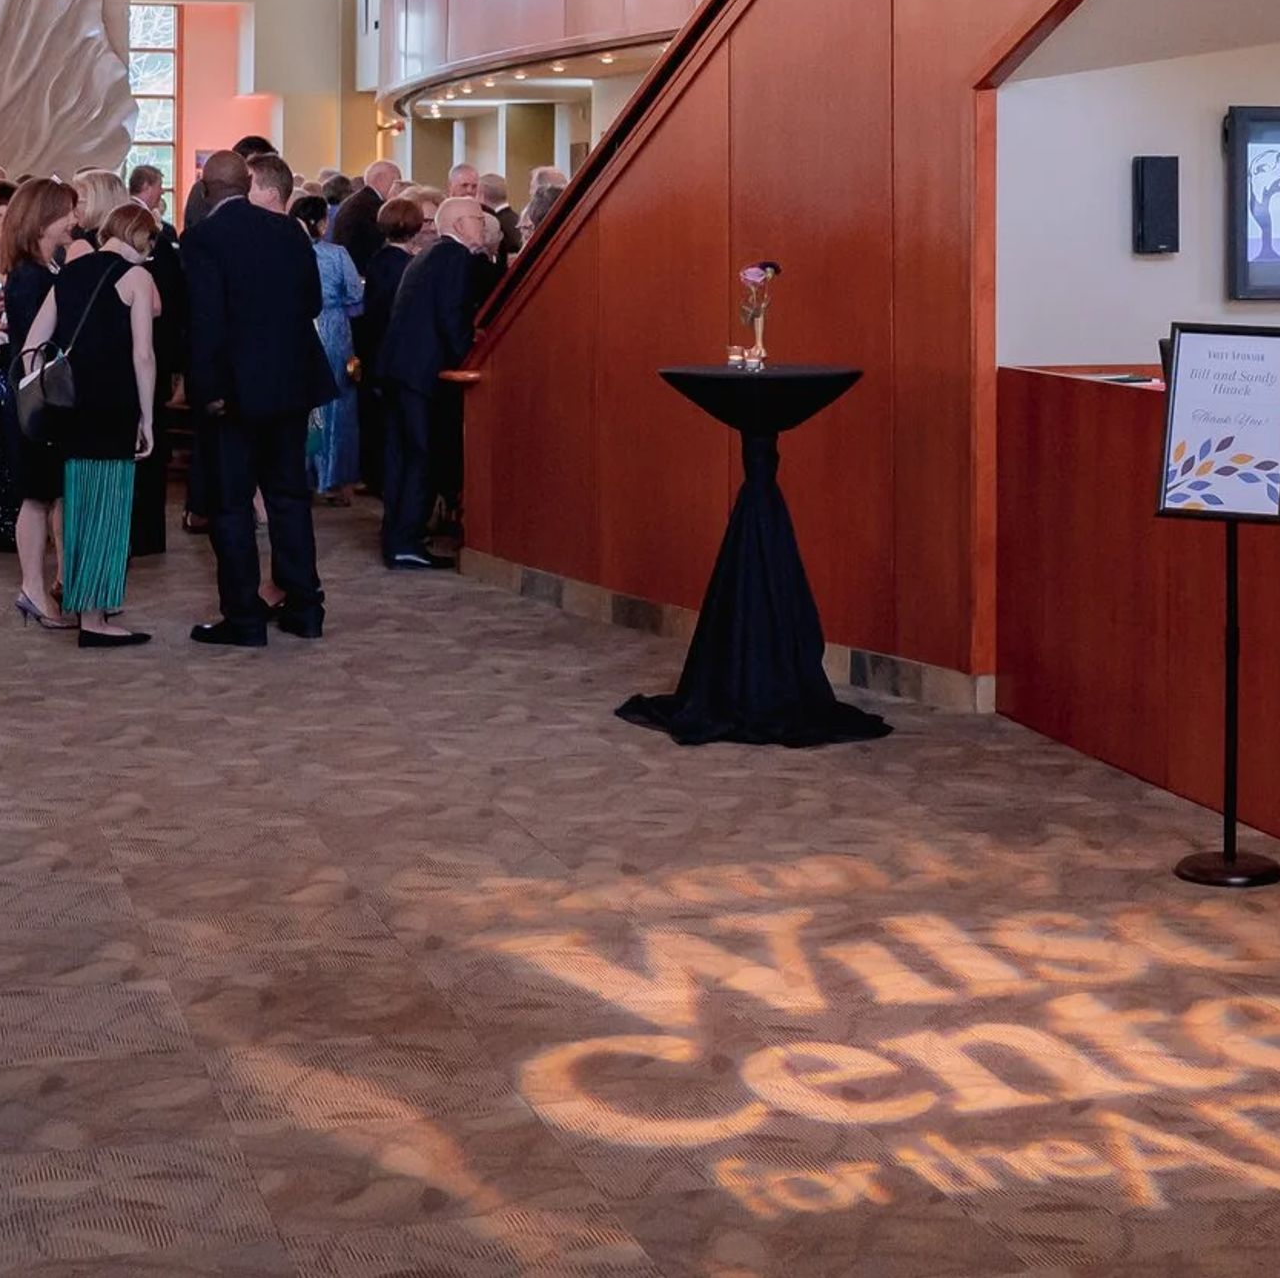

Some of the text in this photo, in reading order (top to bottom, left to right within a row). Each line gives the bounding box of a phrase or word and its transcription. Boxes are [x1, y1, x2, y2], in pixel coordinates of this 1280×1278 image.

[1190, 368, 1278, 387] Bill and Sandy
[714, 1154, 892, 1218] for
[894, 1132, 1120, 1196] the
